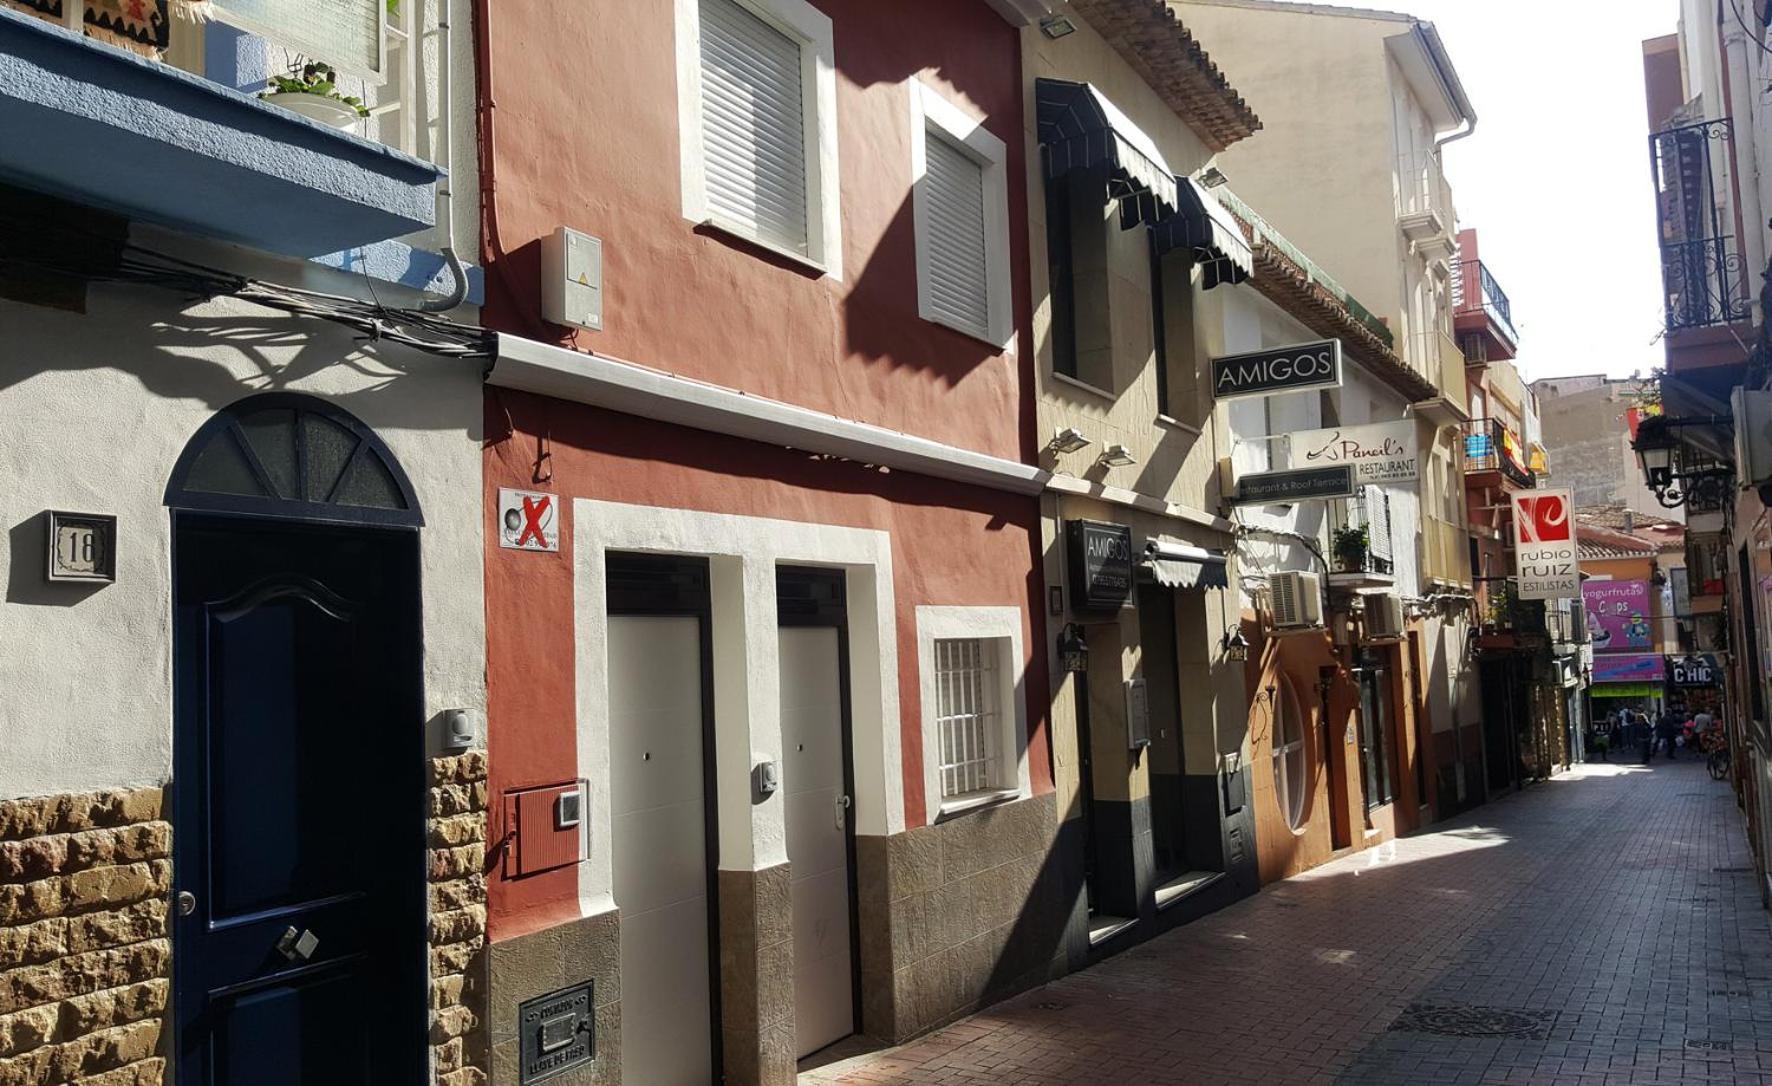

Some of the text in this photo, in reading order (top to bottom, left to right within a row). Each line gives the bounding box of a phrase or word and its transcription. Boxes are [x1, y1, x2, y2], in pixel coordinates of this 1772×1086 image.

[1217, 351, 1331, 389] AMIGOS
[1359, 458, 1416, 475] RESTAURANT
[69, 532, 96, 563] 18
[1087, 536, 1129, 560] AMIGOS
[1520, 549, 1572, 562] rubio
[1521, 563, 1573, 578] ruiz
[1523, 579, 1575, 593] ESTILISTAS
